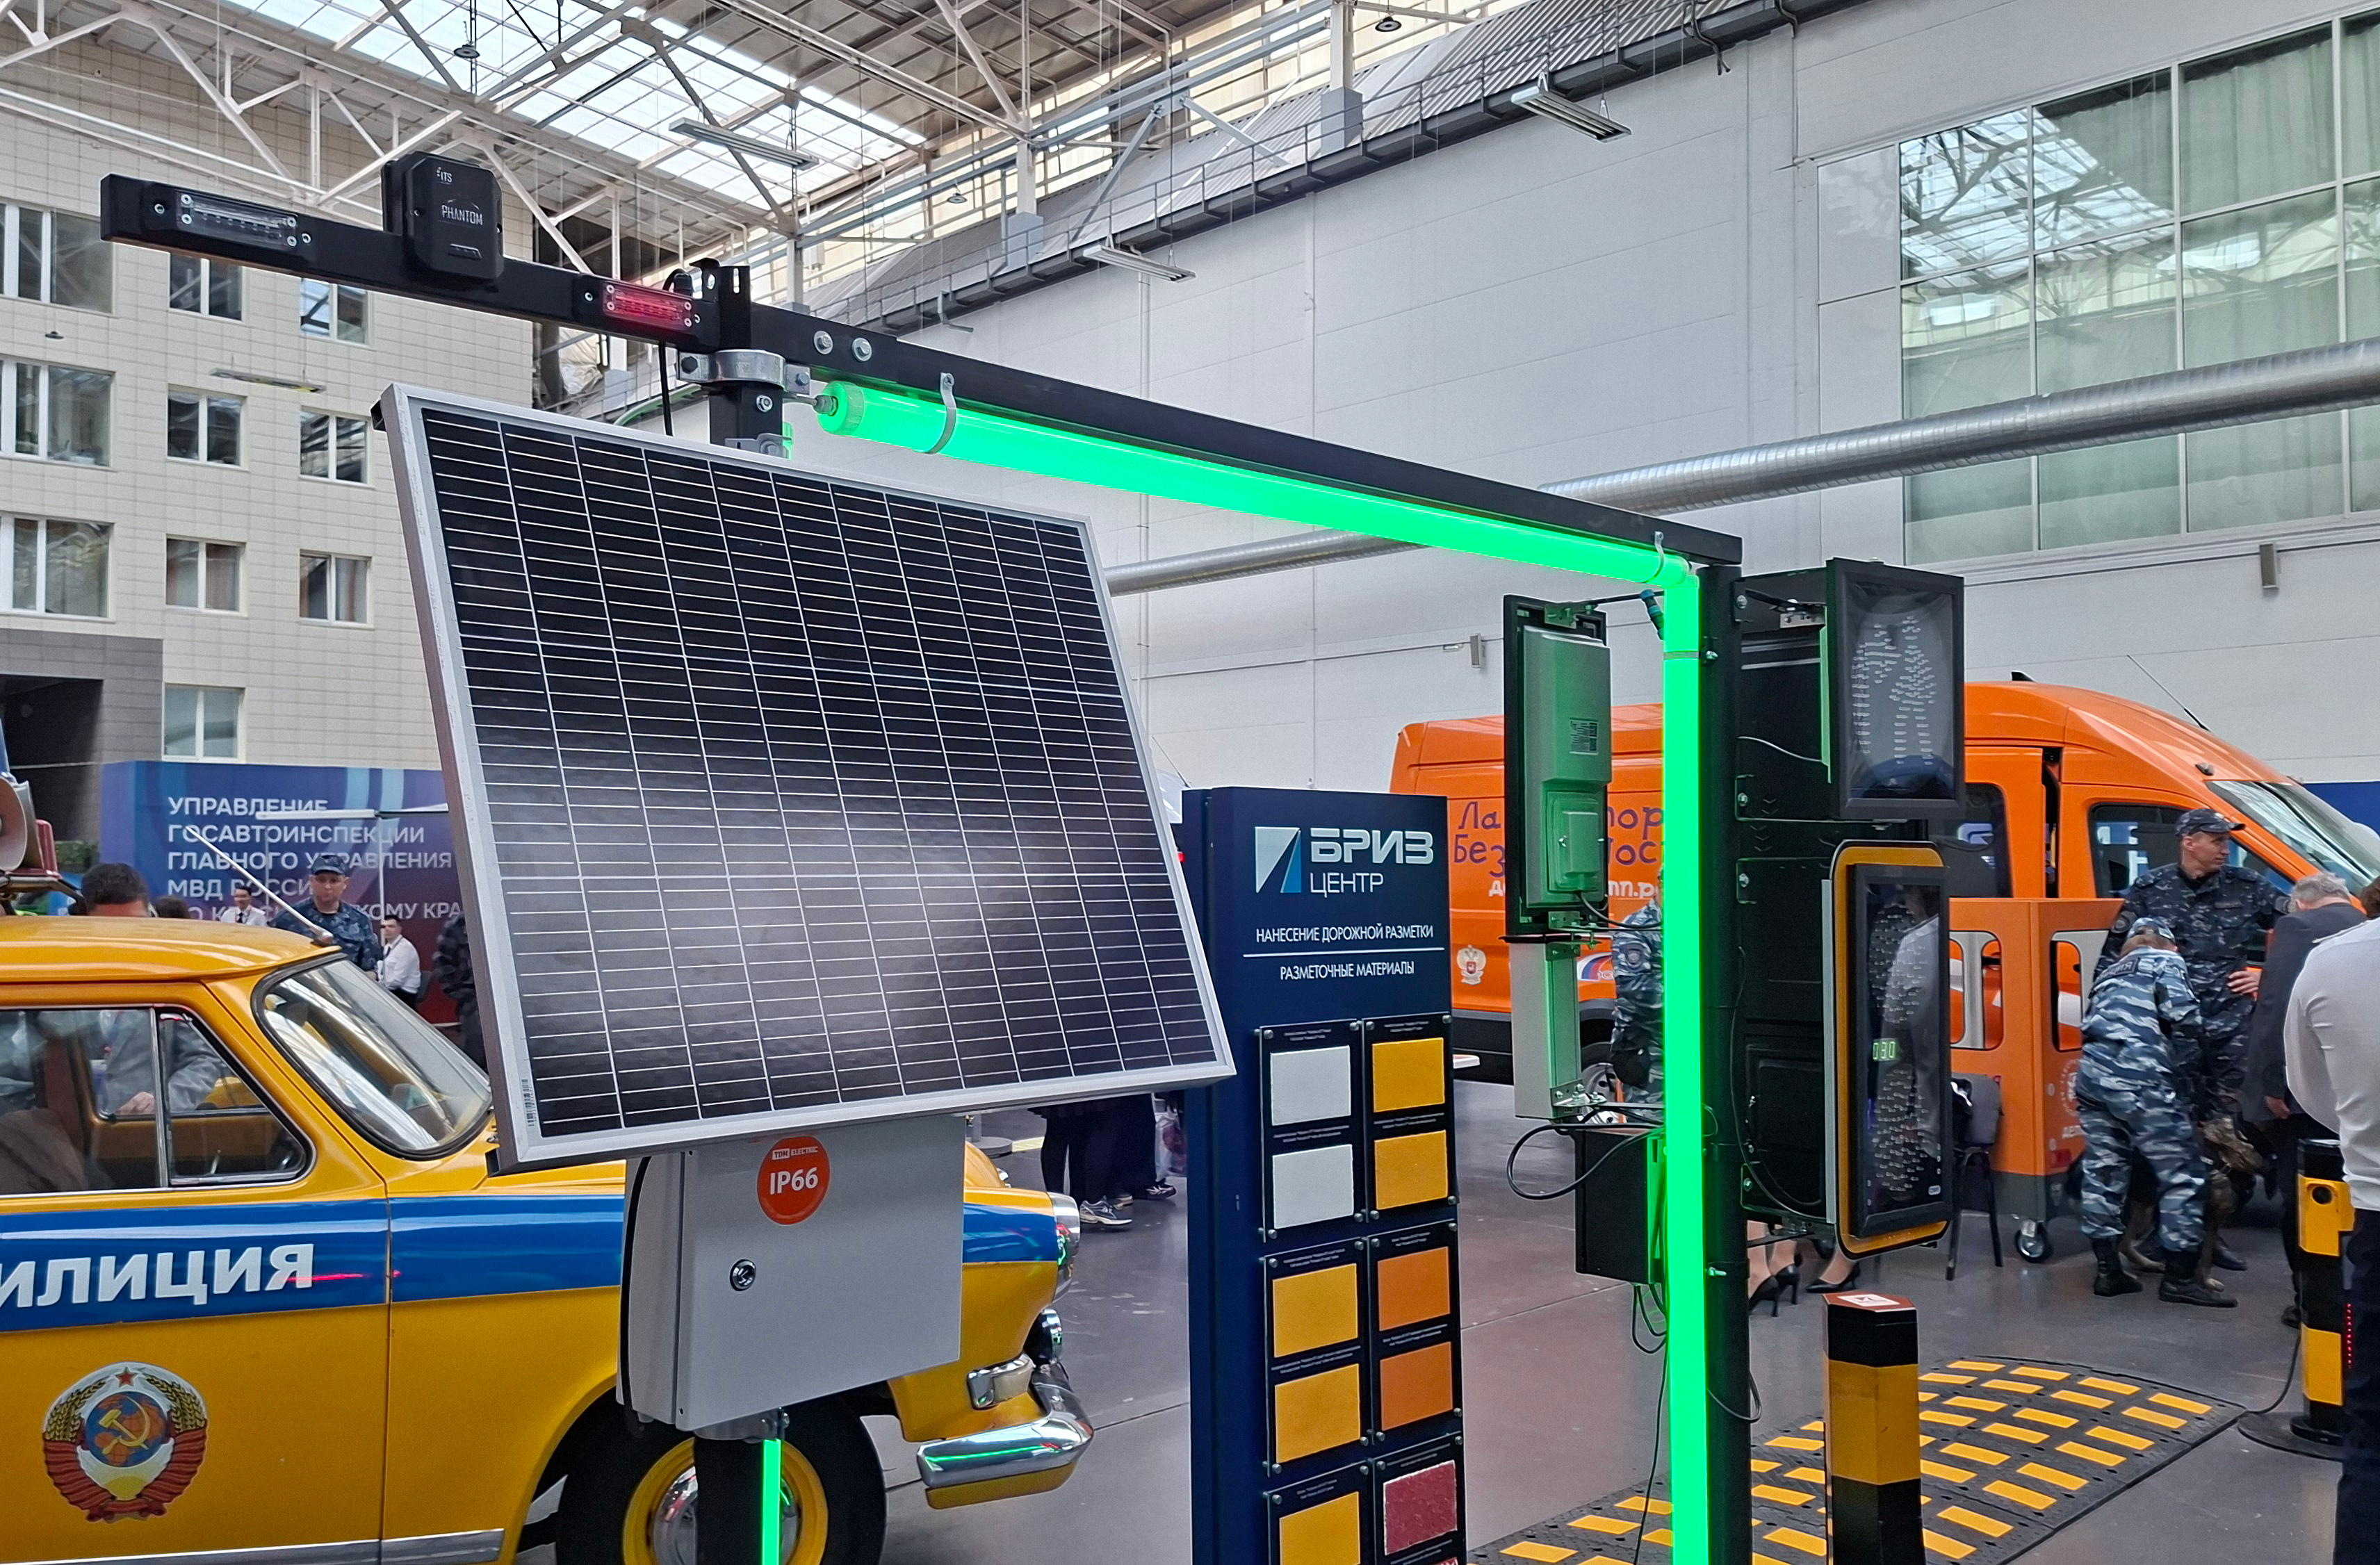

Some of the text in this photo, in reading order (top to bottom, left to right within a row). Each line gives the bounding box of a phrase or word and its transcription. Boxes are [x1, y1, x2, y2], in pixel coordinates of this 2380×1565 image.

[441, 204, 483, 226] PHANTOM
[168, 796, 329, 816] УПРАВЛЕНИЕ
[168, 824, 425, 847] ГОСАВТОИНСПЕКЦИИ
[1310, 827, 1434, 865] БРИЗ
[168, 851, 299, 869] ГЛАВНОГО
[168, 878, 224, 901] МВД
[1310, 871, 1384, 899] ЦЕНТР
[1256, 922, 1434, 943] НАНЕСЕНИЕ ДОРОЖНОЙ РАЗМЕТКИ
[1280, 960, 1415, 981] РАЗМЕТОЧНЫЕ МАТЕРИАЛЫ
[769, 1166, 819, 1195] IP66
